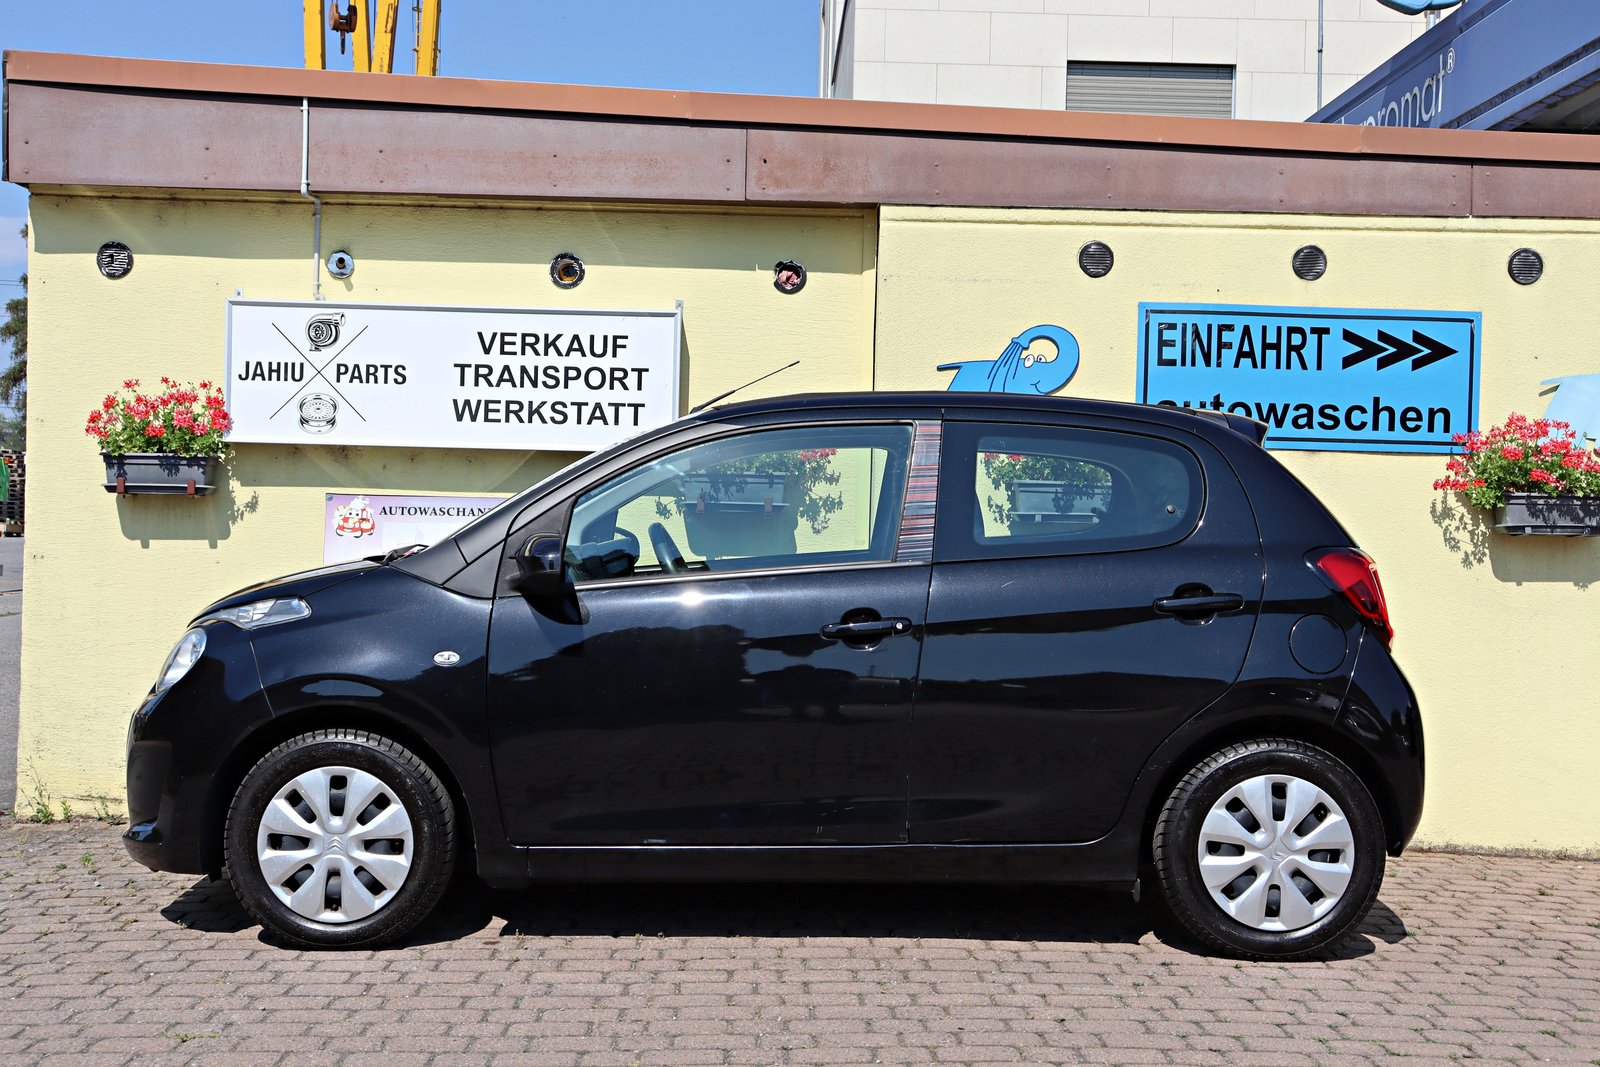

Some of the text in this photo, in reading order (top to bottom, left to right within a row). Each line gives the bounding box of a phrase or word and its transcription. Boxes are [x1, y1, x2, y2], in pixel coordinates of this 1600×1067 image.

[477, 331, 629, 359] VERKAUF
[1157, 322, 1331, 371] EINFAHRT
[238, 360, 407, 385] JAHIU PARTS
[453, 363, 649, 391] TRANSPORT
[452, 398, 646, 427] WERKSTATT
[379, 506, 491, 517] AUTOWASCHAN
